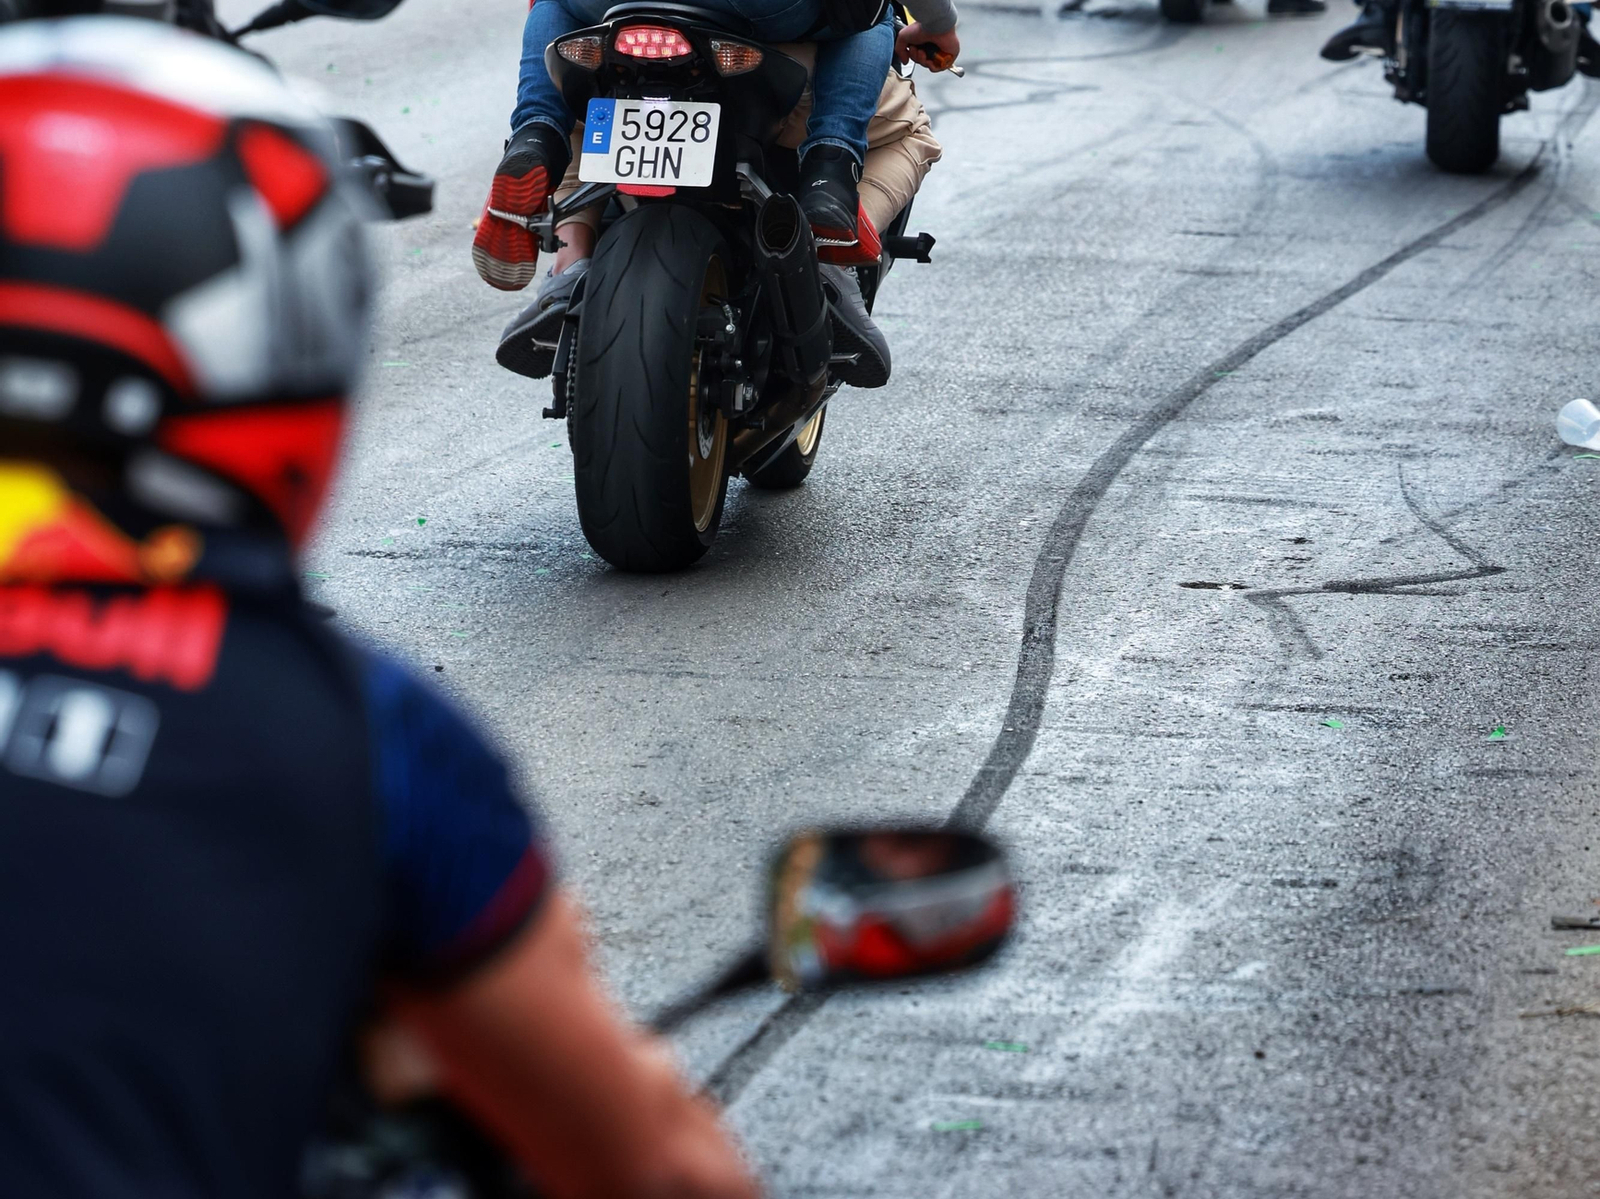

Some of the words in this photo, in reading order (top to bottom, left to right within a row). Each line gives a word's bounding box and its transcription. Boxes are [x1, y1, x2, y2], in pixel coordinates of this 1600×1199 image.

[592, 132, 603, 144] E
[621, 108, 712, 143] 5928
[614, 145, 683, 179] GHN
